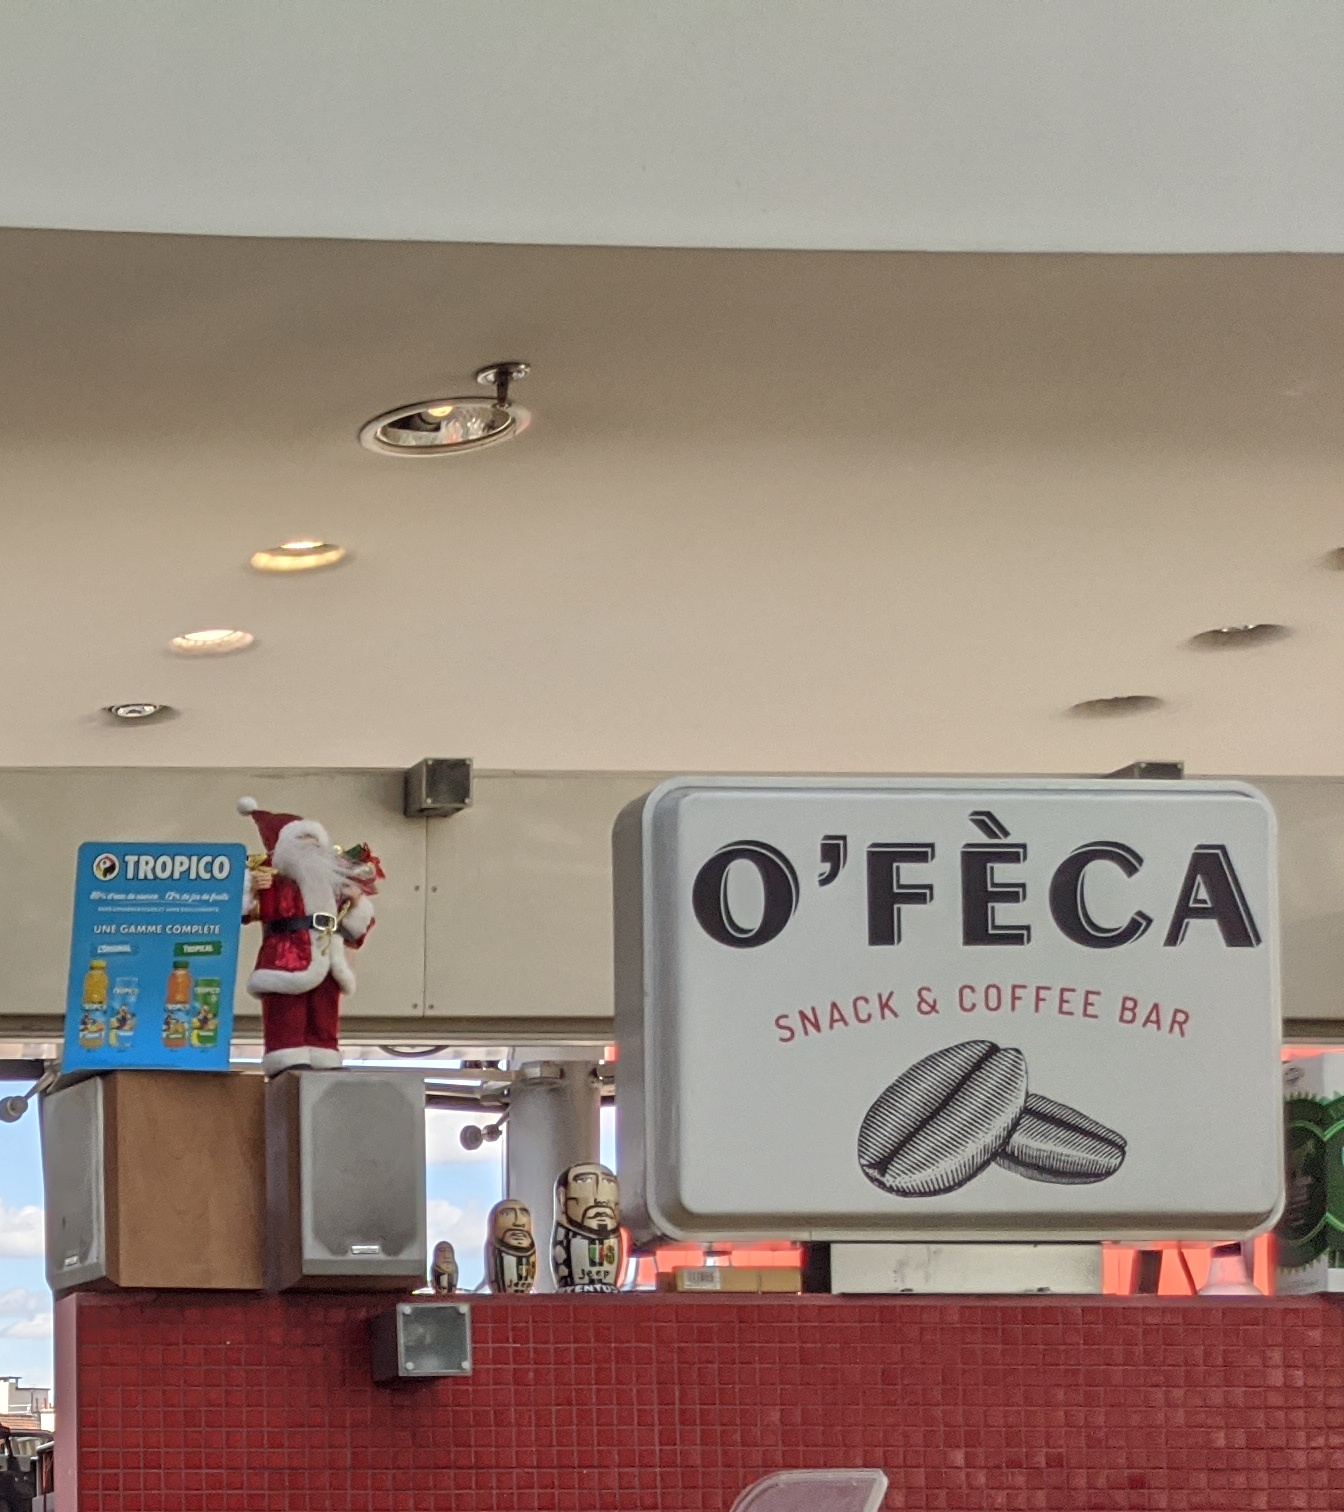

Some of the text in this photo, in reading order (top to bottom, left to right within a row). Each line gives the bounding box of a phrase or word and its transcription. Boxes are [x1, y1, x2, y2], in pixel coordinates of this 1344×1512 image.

[125, 855, 231, 880] TROPICO
[94, 925, 116, 934] UNE
[120, 925, 162, 934] GAMME
[775, 983, 1191, 1044] SNACK & COFFEE BAR
[578, 1268, 611, 1281] Jeep
